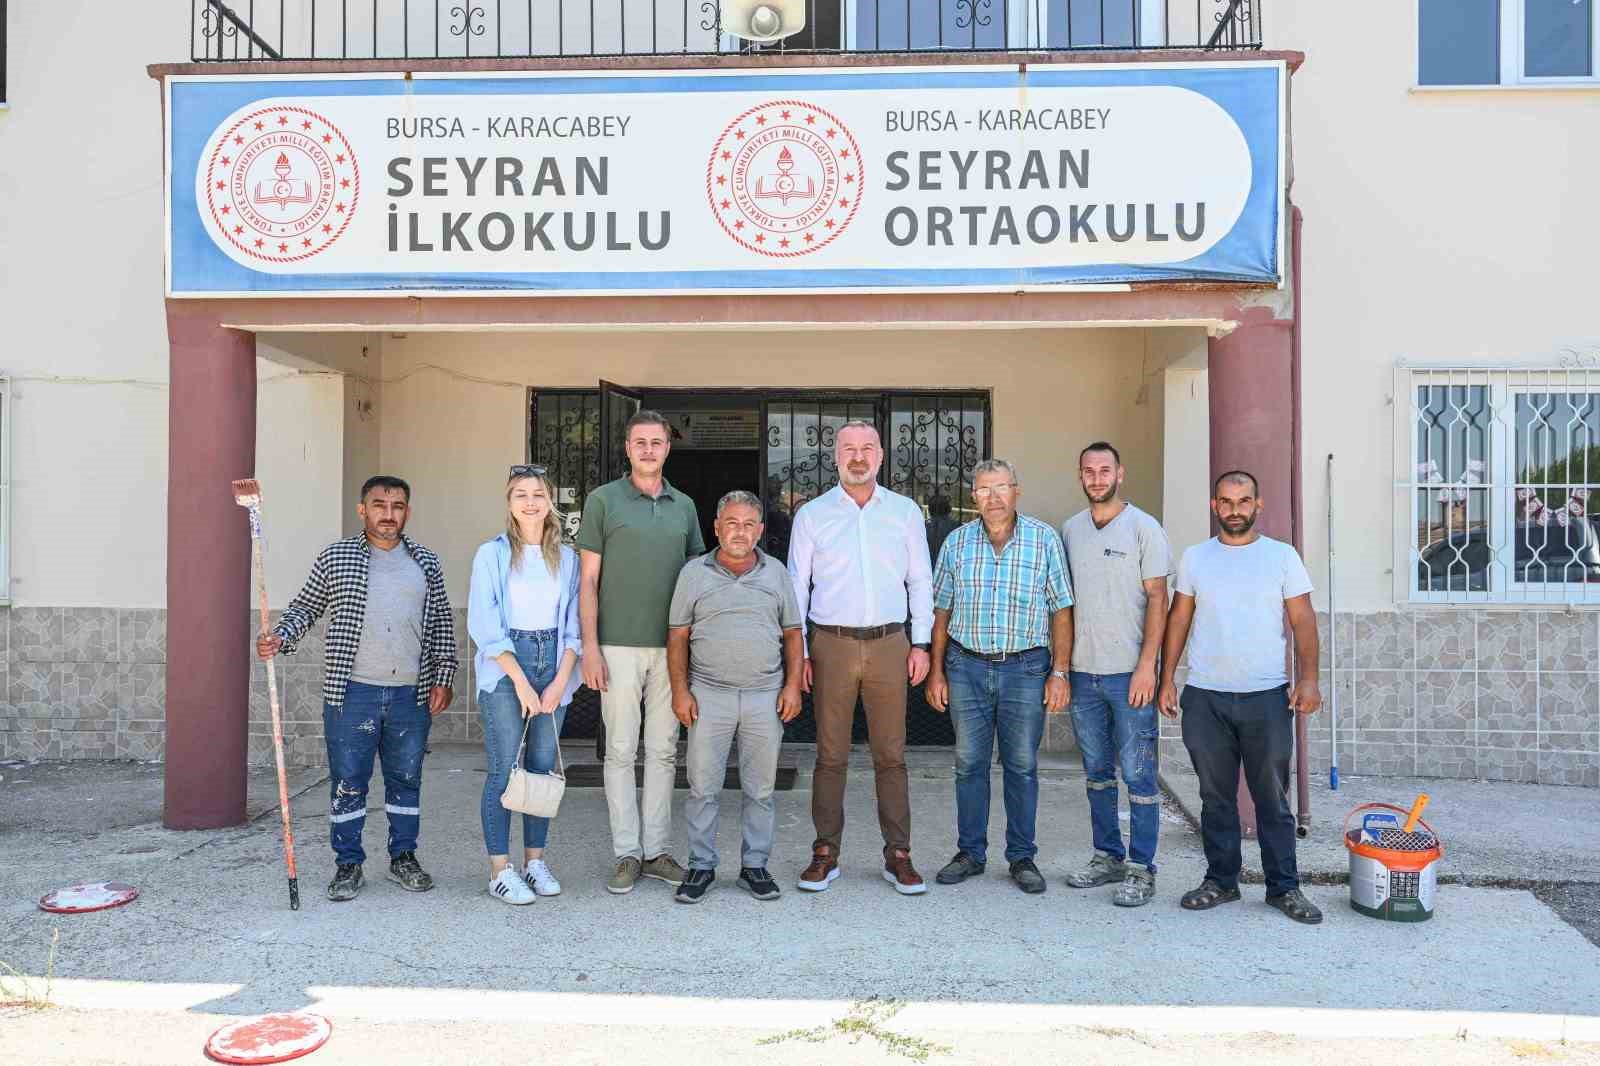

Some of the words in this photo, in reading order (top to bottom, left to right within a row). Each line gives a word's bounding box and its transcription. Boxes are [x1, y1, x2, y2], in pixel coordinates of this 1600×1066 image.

[386, 117, 465, 138] BURSA
[487, 115, 631, 138] KARACABEY
[885, 110, 958, 132] BURSA
[978, 108, 1111, 131] KARACABEY
[386, 156, 609, 197] SEYRAN
[885, 149, 1090, 191] SEYRAN
[388, 203, 671, 252] İLKOKULU
[884, 202, 1206, 246] ORTAOKULU
